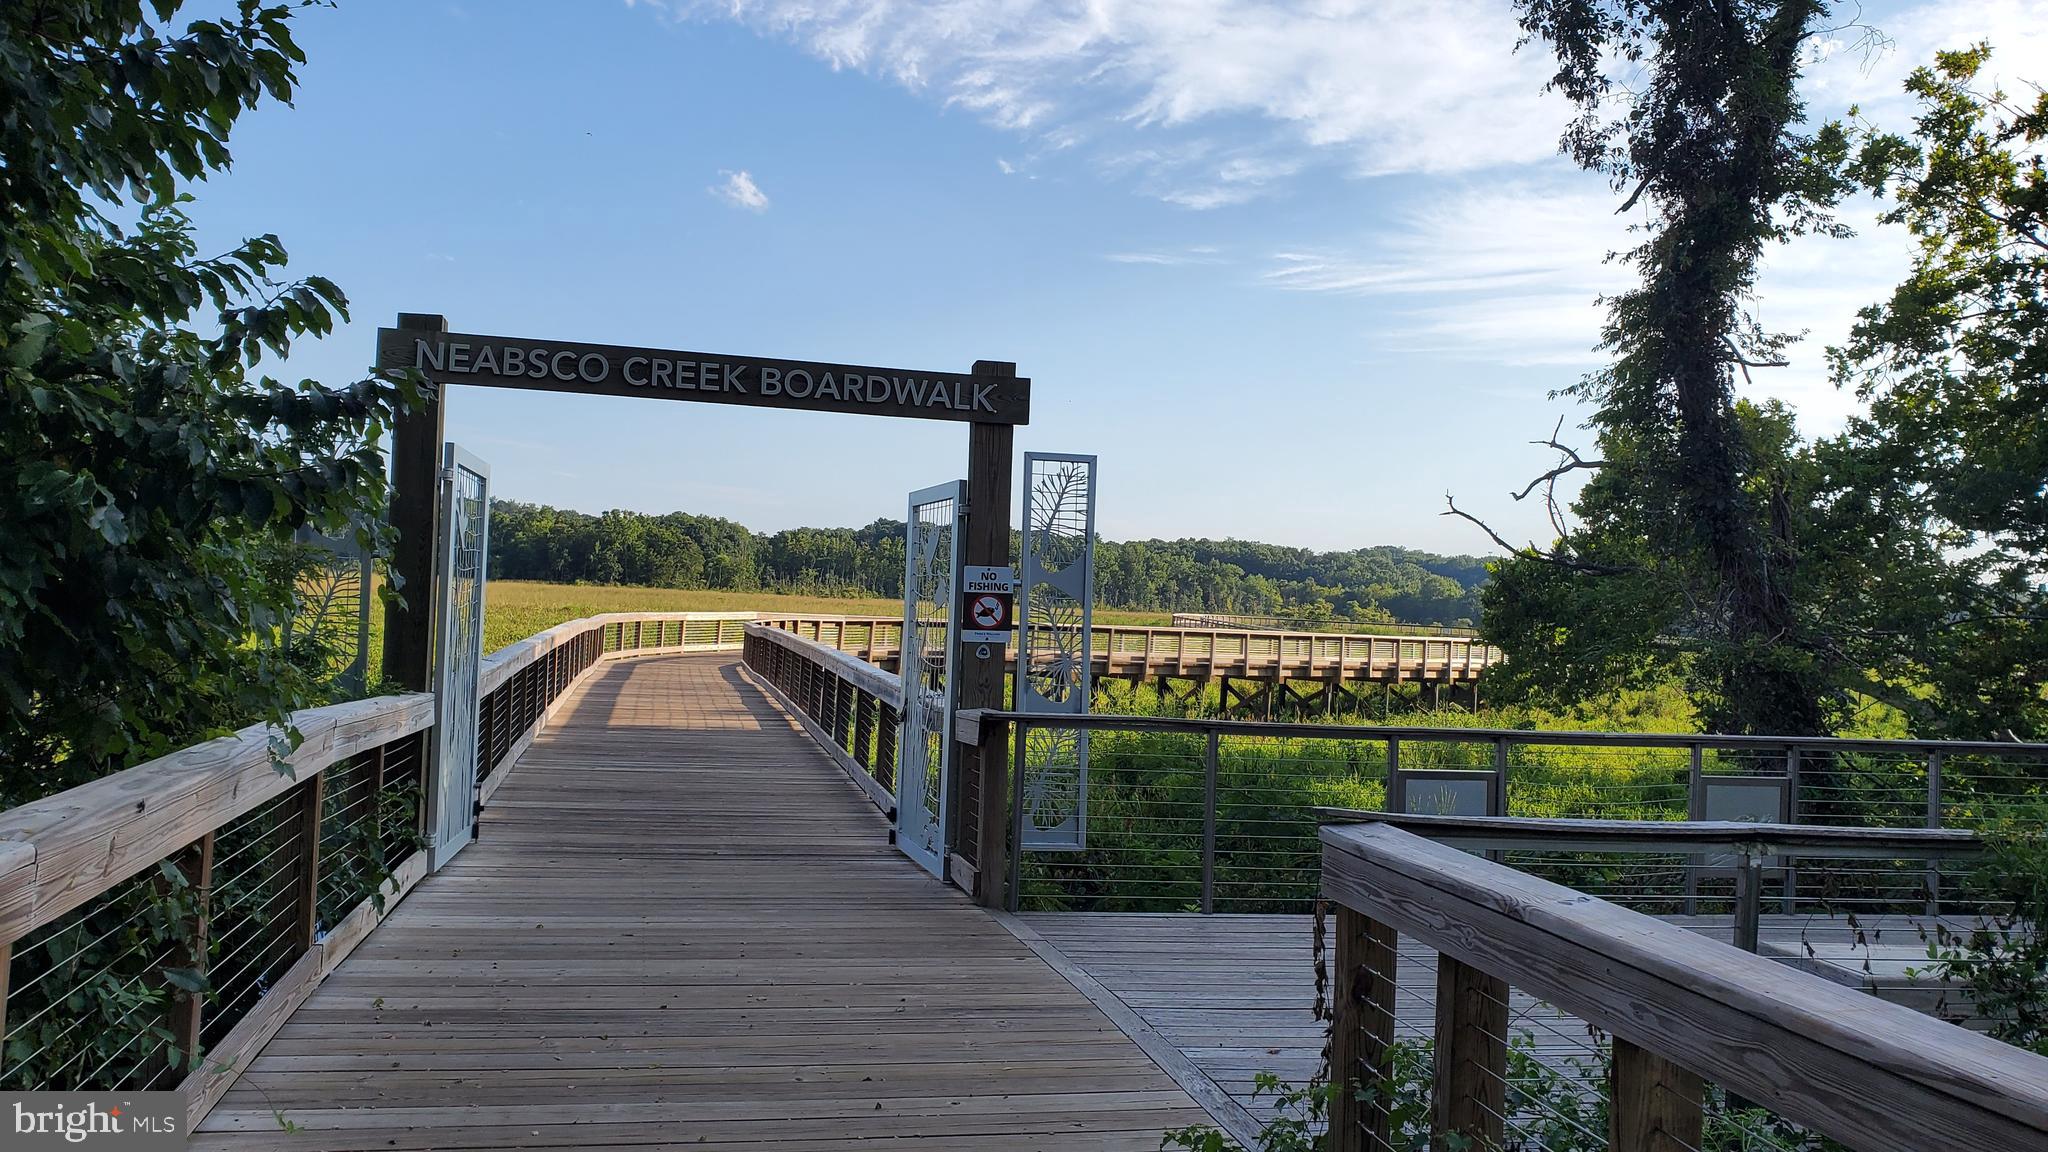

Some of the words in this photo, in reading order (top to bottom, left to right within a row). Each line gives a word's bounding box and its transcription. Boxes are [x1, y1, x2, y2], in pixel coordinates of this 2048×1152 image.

[414, 338, 610, 383] NEABSCO
[622, 357, 748, 393] CREEK
[760, 366, 998, 413] BOARDWALK
[981, 572, 997, 581] NO
[968, 581, 1009, 591] FISHING
